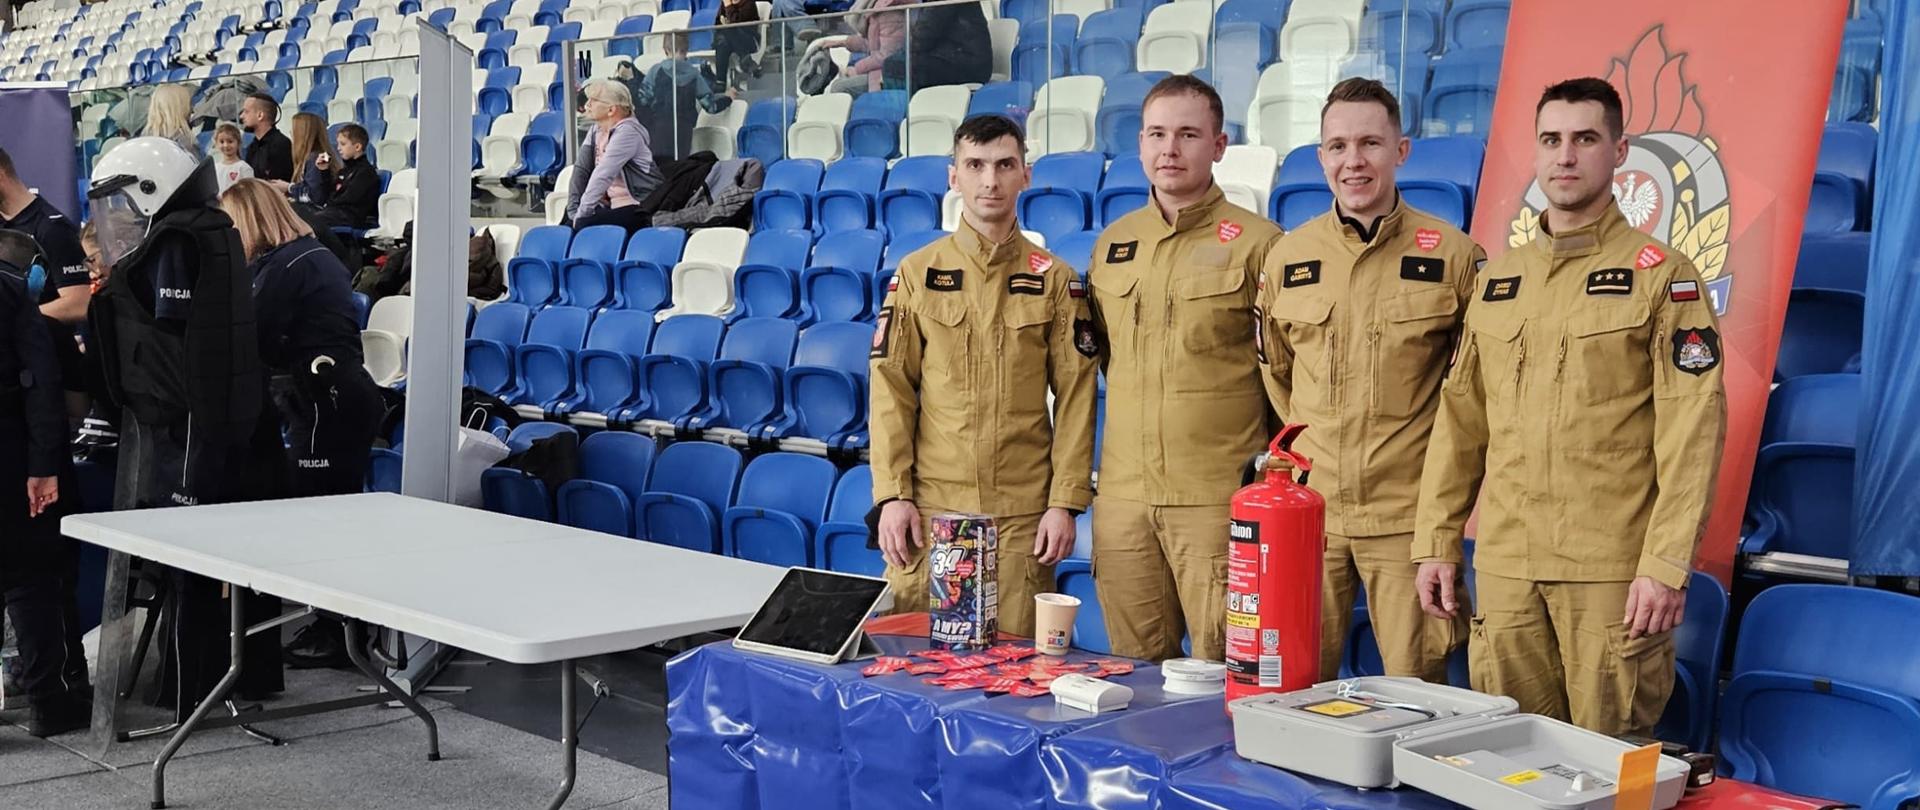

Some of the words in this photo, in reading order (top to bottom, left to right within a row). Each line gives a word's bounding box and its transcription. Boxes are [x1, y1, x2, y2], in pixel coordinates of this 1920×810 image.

[579, 50, 592, 79] M
[160, 287, 191, 299] POCJA
[299, 459, 329, 468] POLICJA
[934, 547, 964, 576] 34
